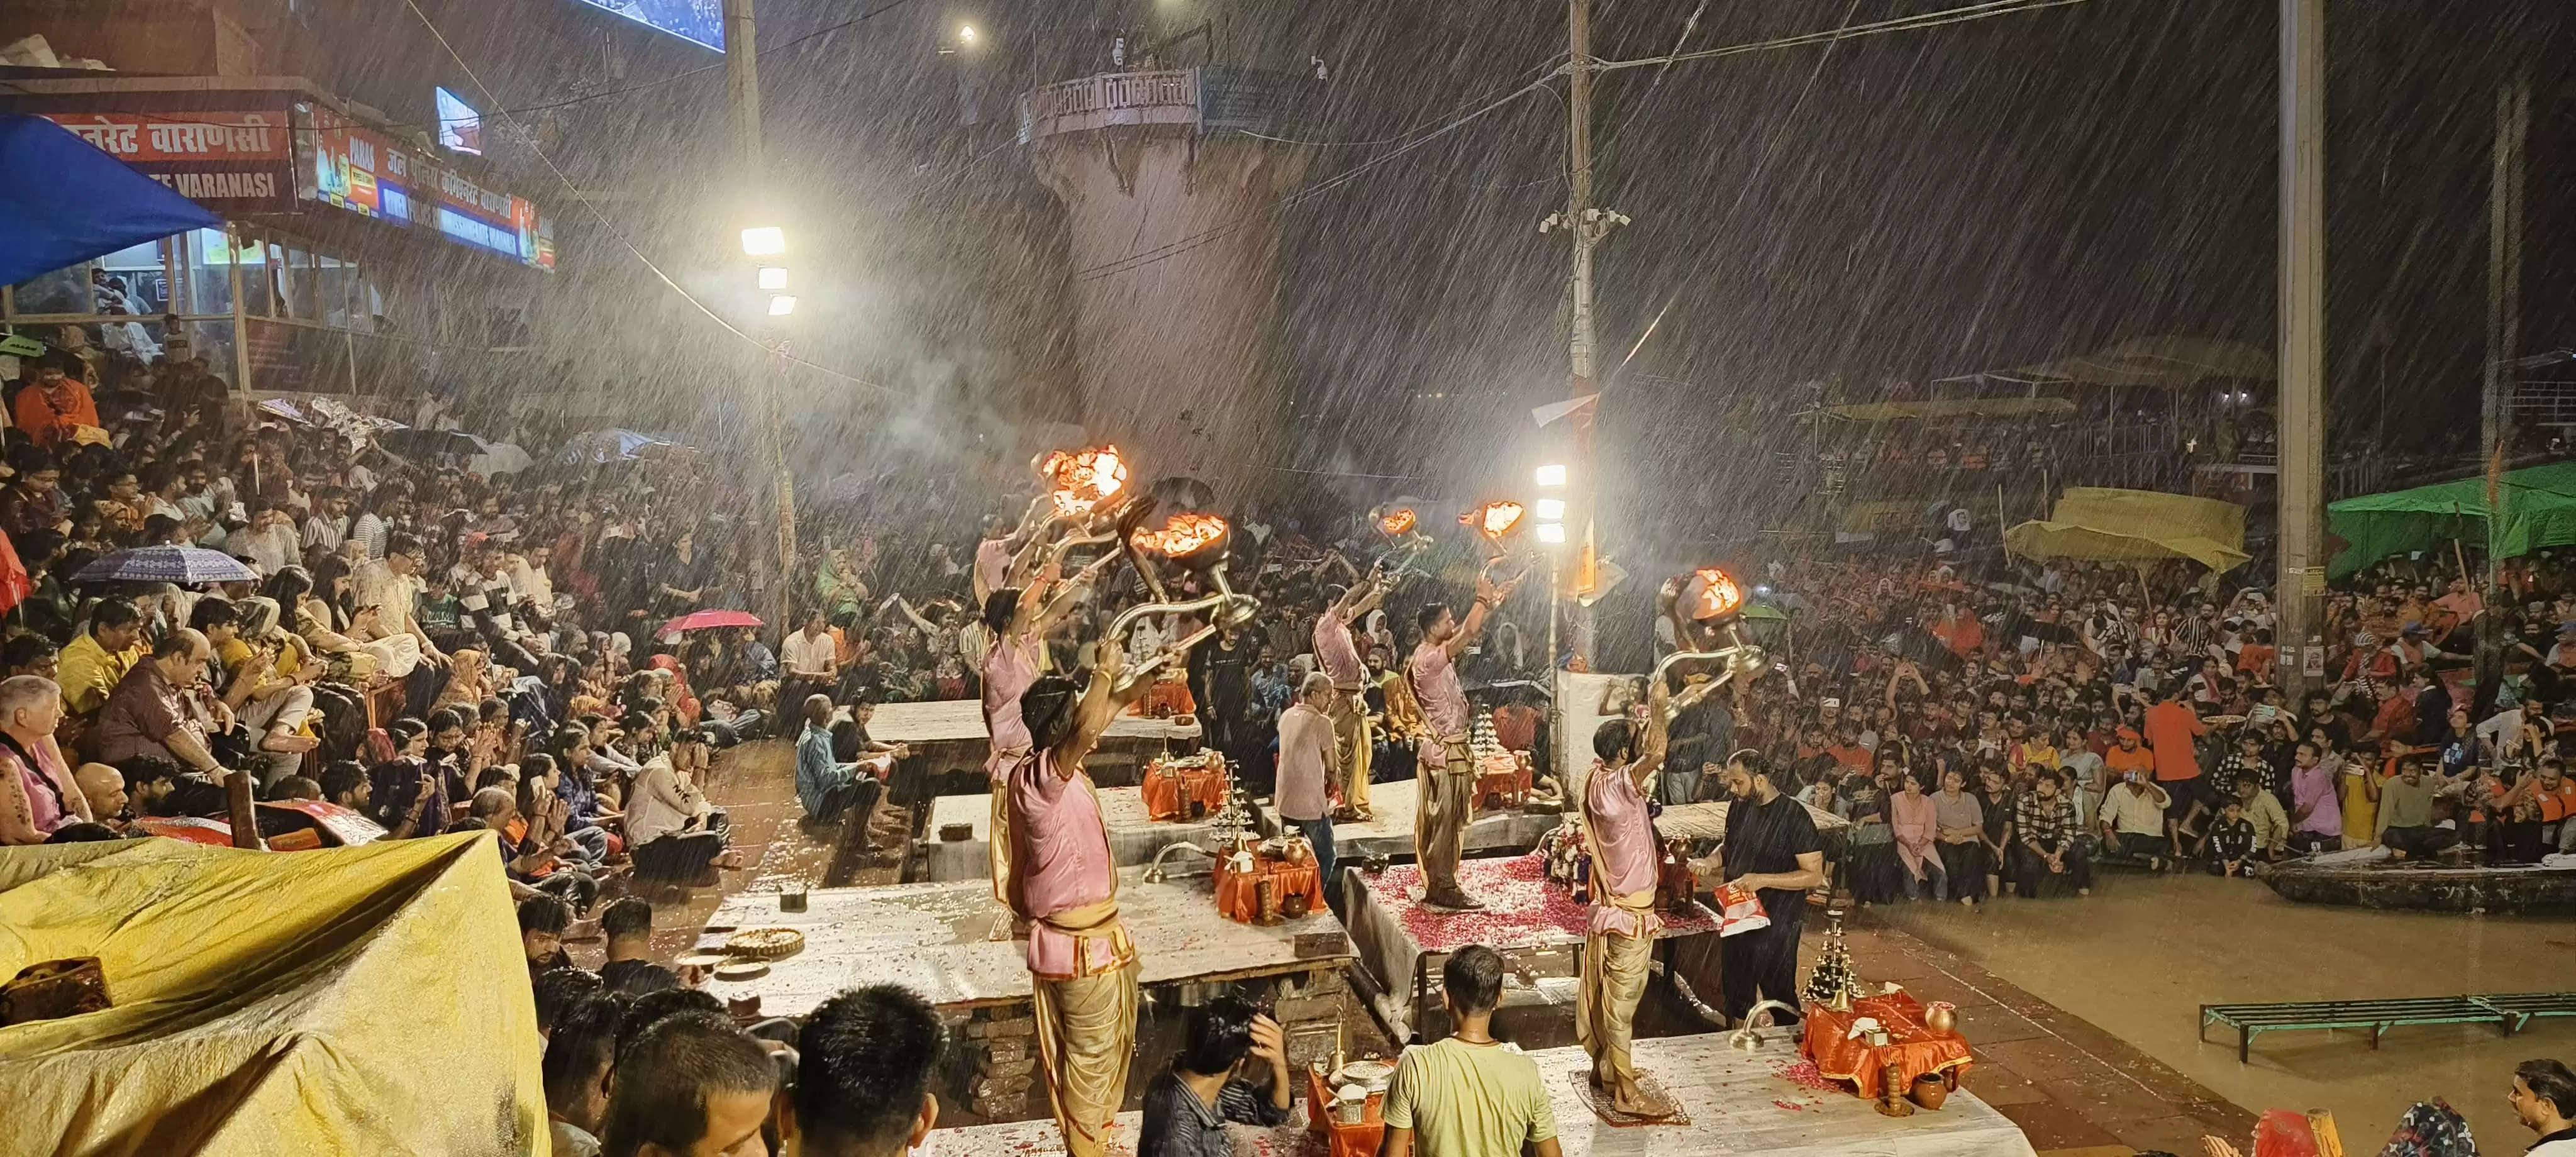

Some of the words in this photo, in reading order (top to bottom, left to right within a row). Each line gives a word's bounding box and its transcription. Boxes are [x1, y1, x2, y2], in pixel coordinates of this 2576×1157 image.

[147, 114, 271, 152] वाराणसी
[386, 147, 408, 177] जल
[175, 172, 275, 197] VARANASI
